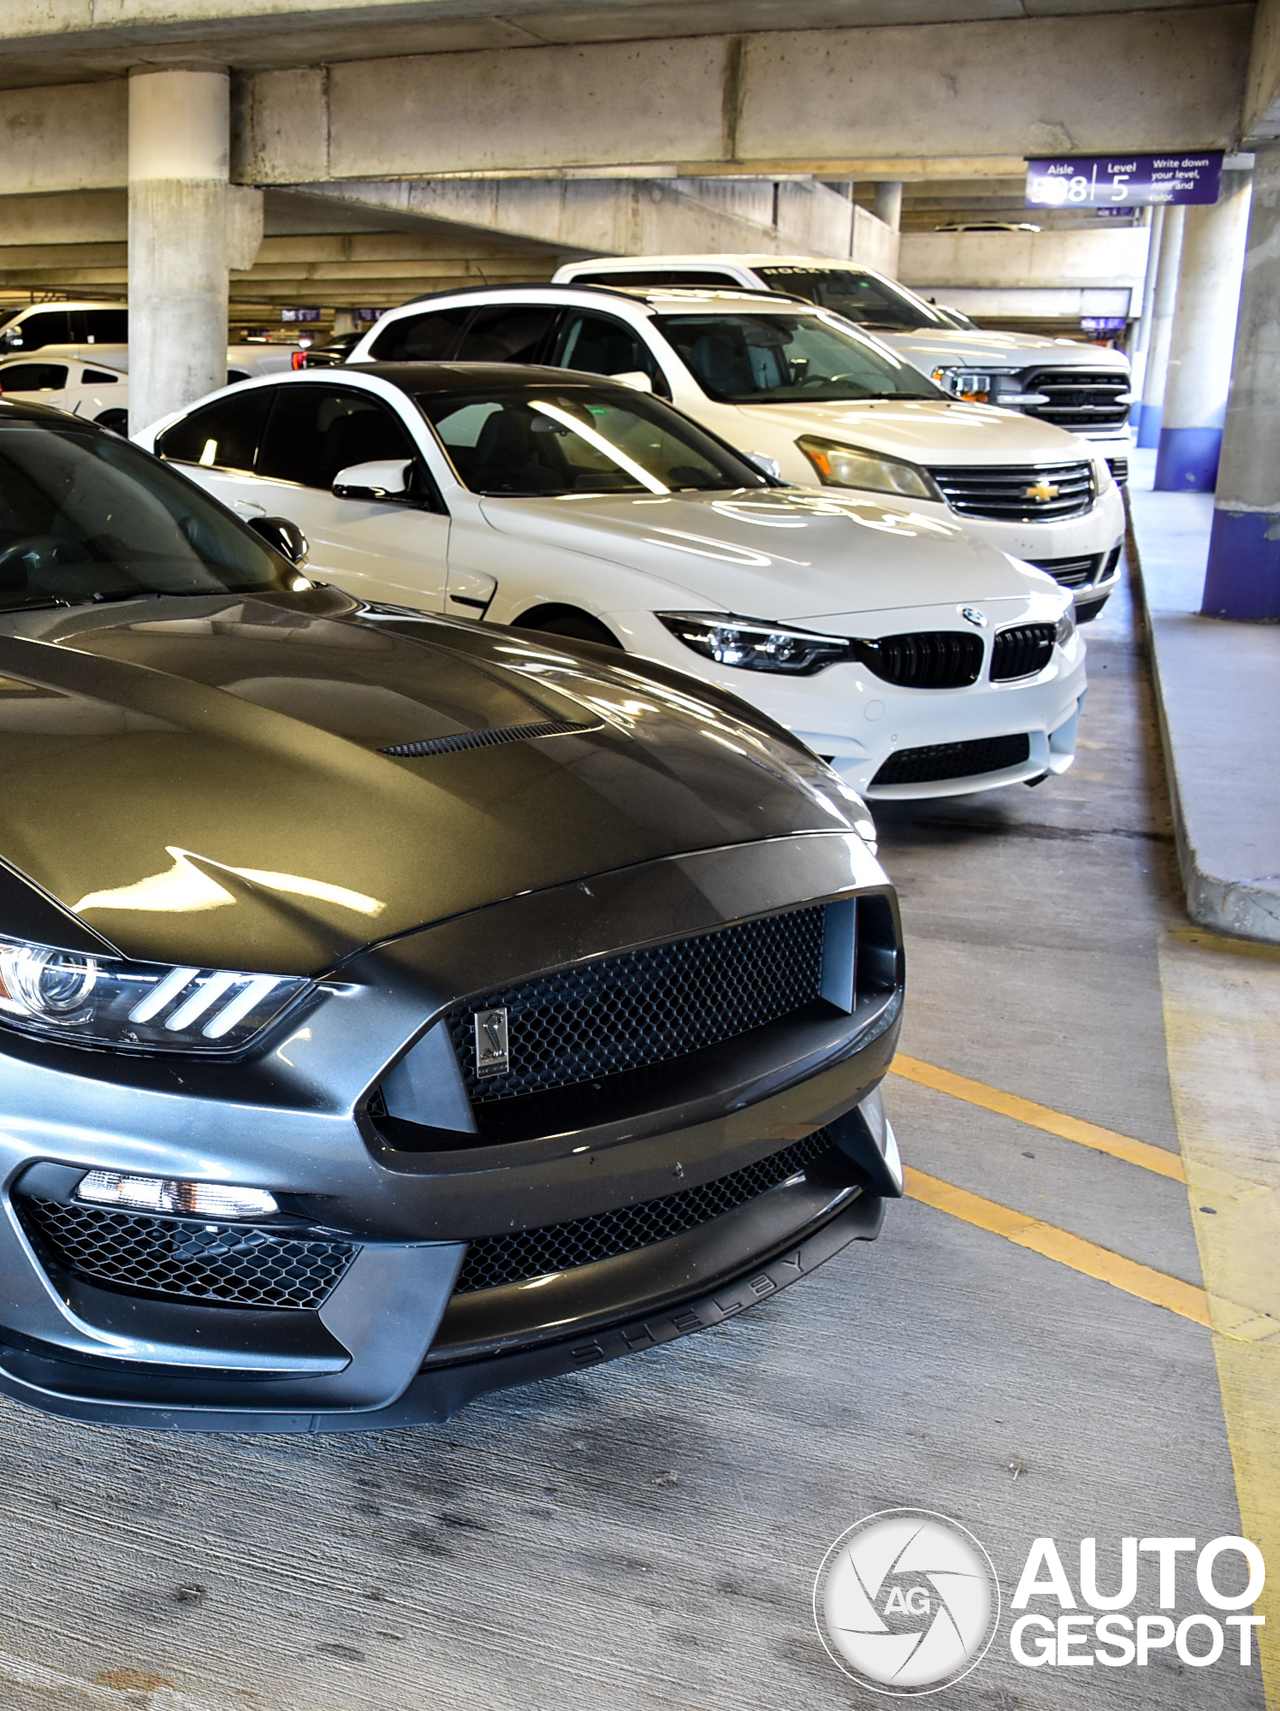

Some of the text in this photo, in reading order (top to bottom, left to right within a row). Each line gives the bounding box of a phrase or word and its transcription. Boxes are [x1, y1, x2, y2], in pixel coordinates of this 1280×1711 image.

[1047, 162, 1137, 174] Aisle Level
[1153, 158, 1209, 168] Write down
[1151, 172, 1174, 181] your
[1031, 175, 1129, 204] 58 5
[1174, 180, 1194, 190] and
[571, 1251, 805, 1366] SHELBY
